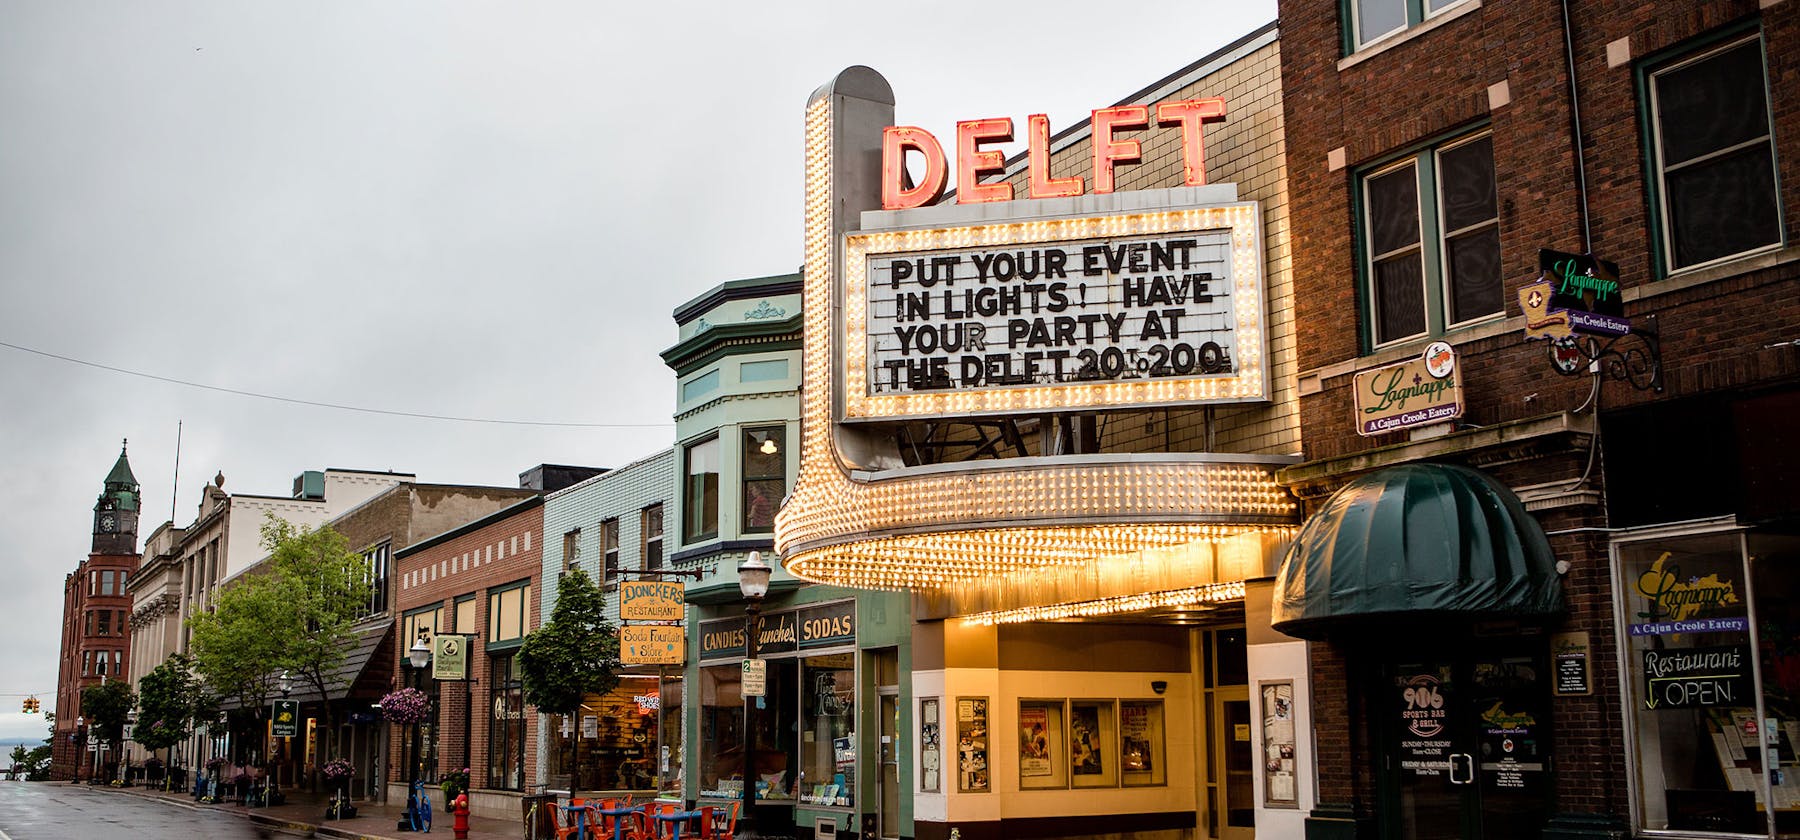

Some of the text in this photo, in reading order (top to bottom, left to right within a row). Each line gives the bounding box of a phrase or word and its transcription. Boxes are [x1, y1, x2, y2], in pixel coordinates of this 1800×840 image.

[882, 97, 1226, 210] DELFT
[892, 239, 1197, 289] PUT YOUR EVENT
[896, 291, 930, 322] IN
[1123, 272, 1213, 308] HAVE
[894, 308, 1185, 355] YOUR PARTY AT
[1584, 315, 1607, 328] Creole
[1608, 319, 1629, 334] Eatery
[884, 355, 950, 390] THE
[961, 349, 1070, 386] DELFT
[1365, 367, 1455, 414] Lagniappe
[1370, 406, 1456, 431] A Cajun Creole Eatery
[622, 582, 683, 605] DONCKERS
[1637, 565, 1732, 619] Lagniappe
[628, 607, 677, 617] RESTAURANT
[624, 629, 682, 642] Soda Fountain
[803, 615, 851, 641] SODAS
[1633, 619, 1743, 635] A Cajun Creole Eatery
[640, 644, 663, 657] Store
[703, 629, 745, 651] CANDIES
[743, 662, 750, 672] 2
[1646, 648, 1741, 677] Restaurant
[1403, 686, 1444, 710] 906
[1412, 719, 1419, 729] &
[1431, 710, 1445, 718] BAR
